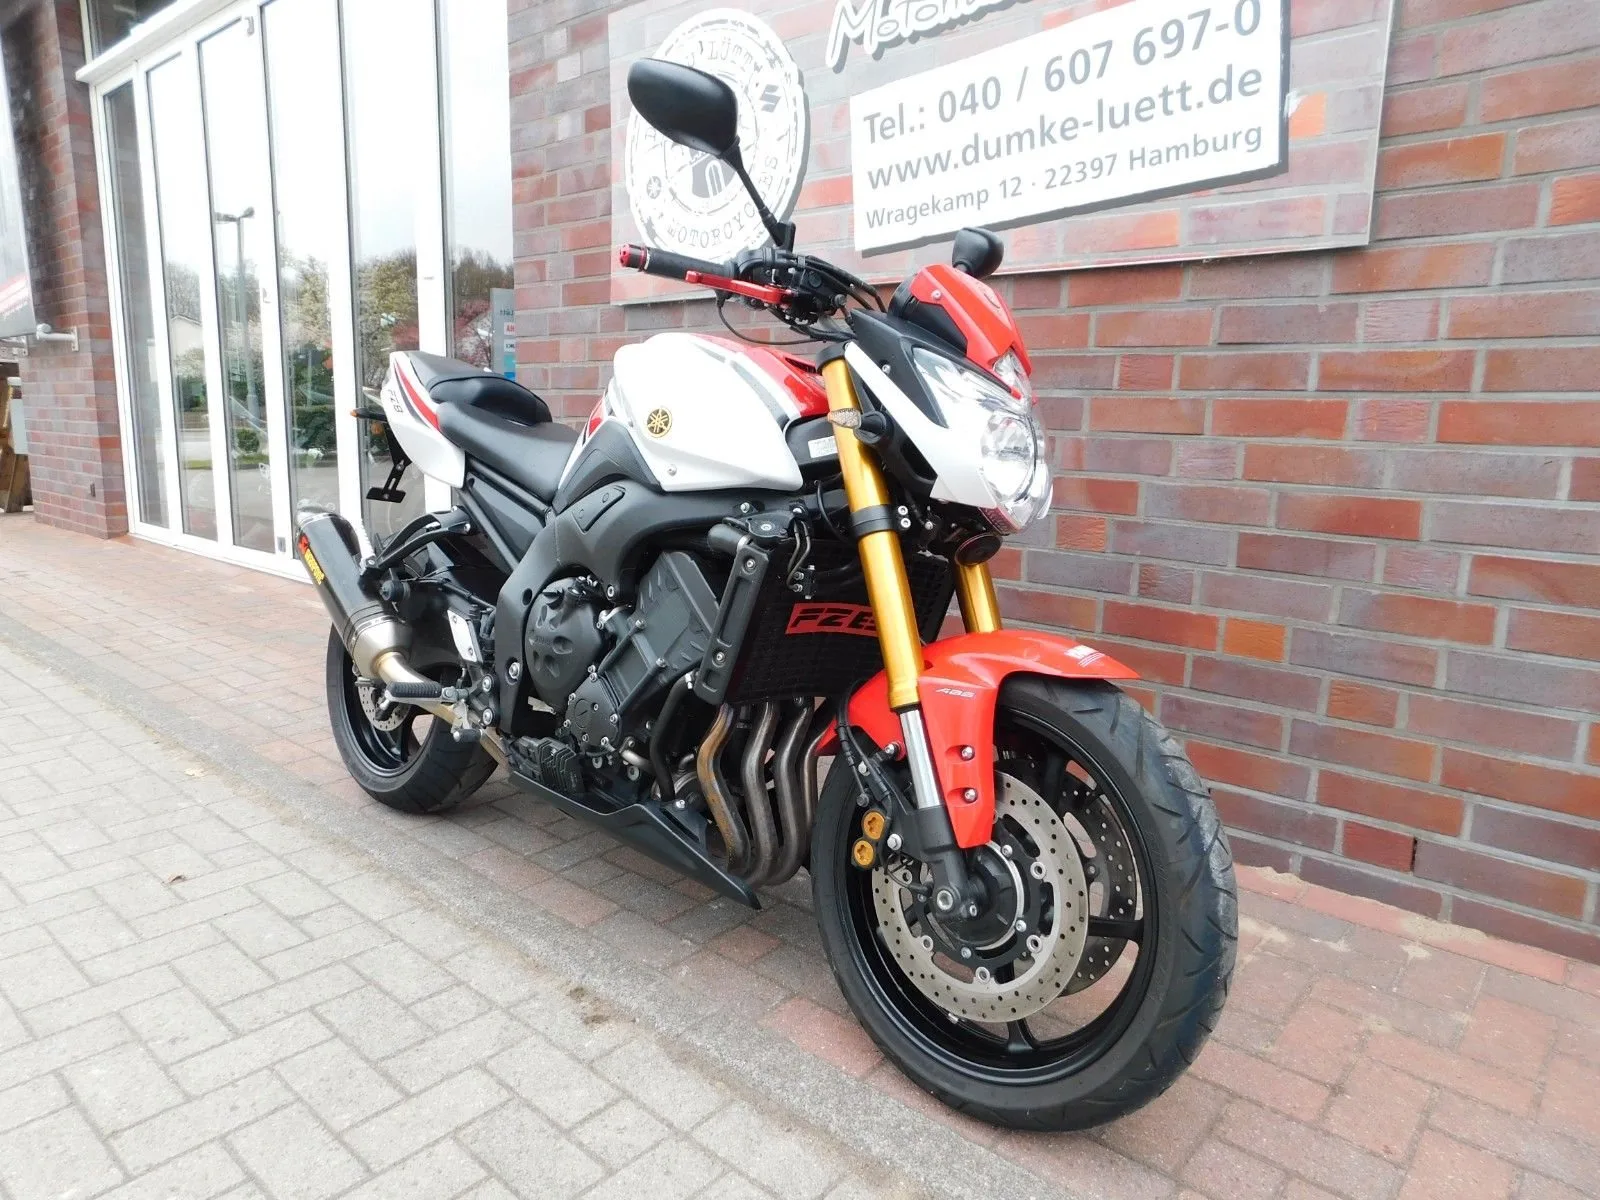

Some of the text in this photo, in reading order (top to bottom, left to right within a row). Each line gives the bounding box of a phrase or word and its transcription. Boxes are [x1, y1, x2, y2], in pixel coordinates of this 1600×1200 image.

[863, 0, 1261, 144] Tel.: 040 / 607 697-0
[867, 63, 1262, 190] www.dumke-luett.de
[866, 188, 989, 229] Wragekamp
[999, 176, 1023, 199] 12
[1044, 153, 1118, 190] 22397
[1129, 126, 1262, 171] Hamburg
[935, 687, 976, 699] ABS
